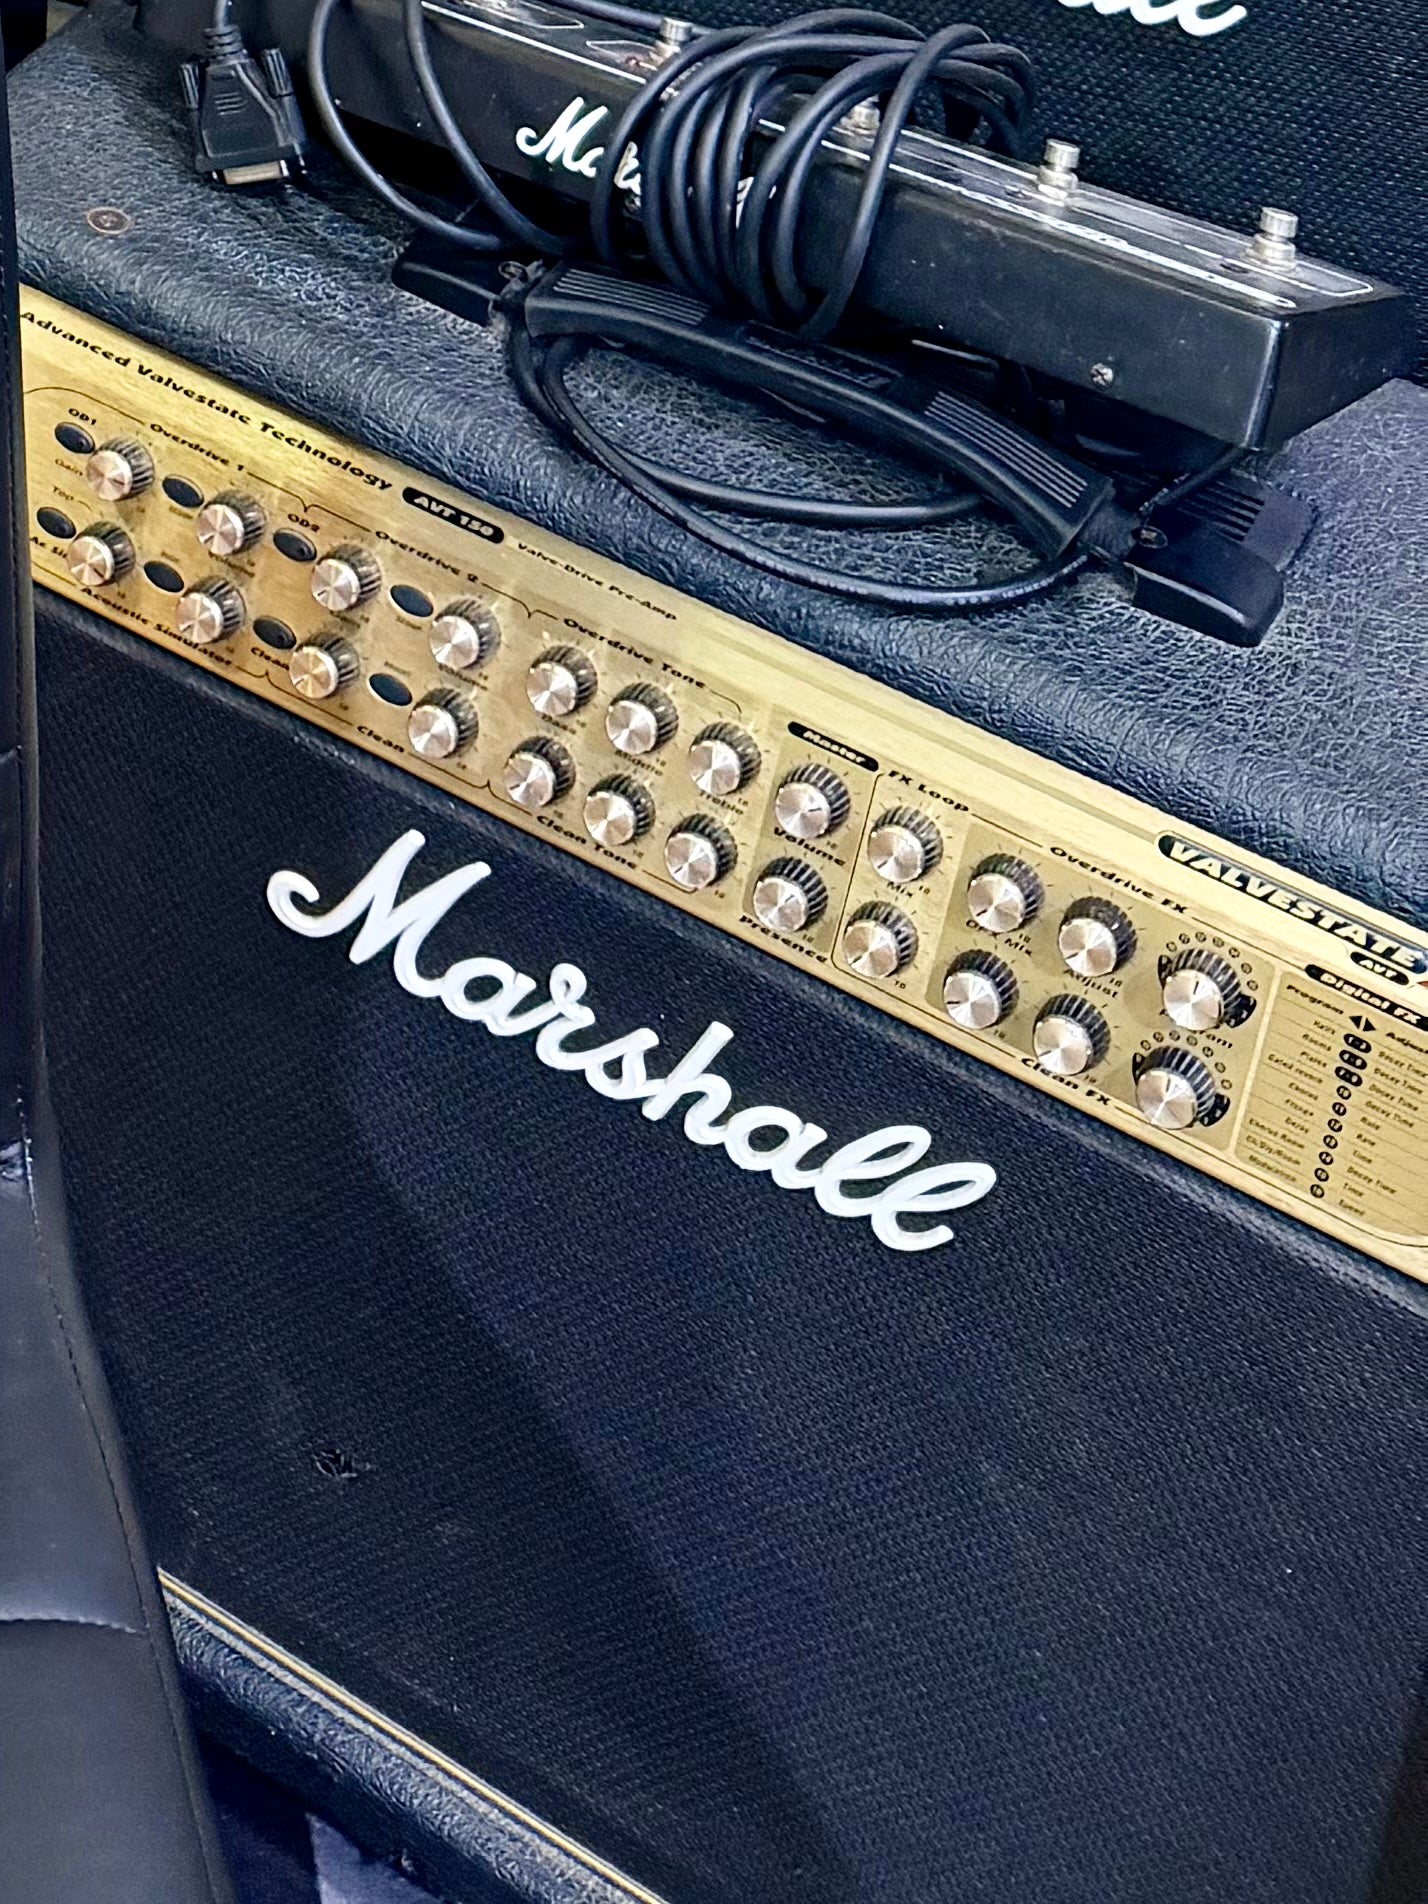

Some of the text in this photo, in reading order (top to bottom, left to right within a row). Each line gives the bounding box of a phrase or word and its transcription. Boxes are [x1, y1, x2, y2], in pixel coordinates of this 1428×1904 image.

[21, 311, 393, 491] Advanced Valvestate Technology
[68, 407, 97, 426] OD1
[149, 423, 230, 466] Overdrive
[287, 513, 321, 533] OD2
[413, 495, 456, 520] AVT
[375, 530, 460, 576] Overdrive
[518, 542, 677, 621] Valve-Drive Pre-Amp
[81, 587, 233, 666] Acoustic Simulator
[251, 647, 290, 670] Clean
[564, 618, 706, 688] Overdrive Tone
[357, 725, 405, 753] Clean
[803, 731, 866, 764] Master
[888, 770, 970, 813] FX Loop
[536, 814, 638, 870] Clean Tone
[774, 827, 847, 867] Volume
[886, 881, 913, 898] Mix
[1050, 846, 1188, 914] Overdrive FX
[1168, 841, 1419, 969] VALVESTATE
[738, 915, 829, 963] Presence
[1004, 937, 1033, 957] Mix
[1357, 958, 1397, 979] AVT
[1286, 984, 1344, 1015] Program
[1319, 972, 1421, 1024] Digital FX
[267, 830, 997, 1252] Marshall
[1020, 1056, 1111, 1107] Clean FX
